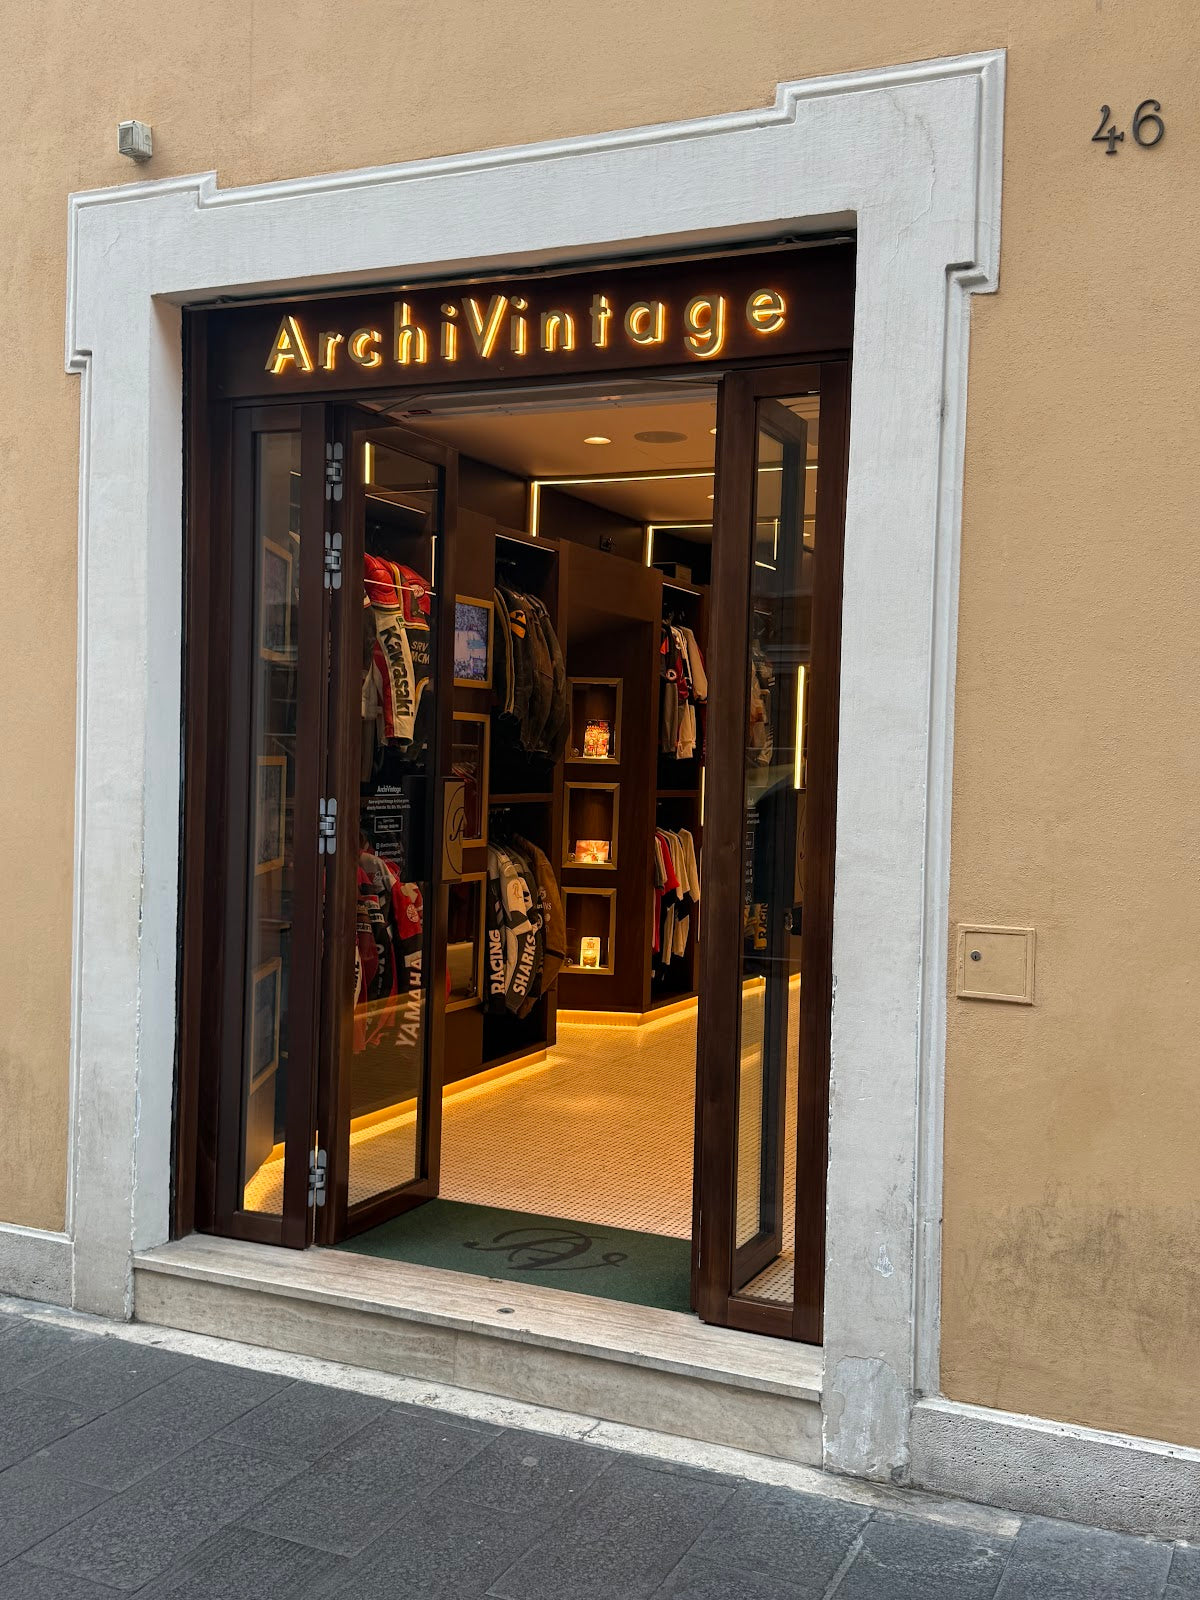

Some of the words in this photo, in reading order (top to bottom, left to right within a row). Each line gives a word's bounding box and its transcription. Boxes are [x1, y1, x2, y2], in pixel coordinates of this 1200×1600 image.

[1091, 99, 1165, 155] 46
[264, 287, 787, 374] ArchiVintage
[379, 625, 414, 718] Kawasaki
[410, 640, 429, 652] SRV
[488, 929, 506, 995] RACING
[512, 933, 537, 996] SHARKS
[395, 958, 423, 1047] YAMAHA
